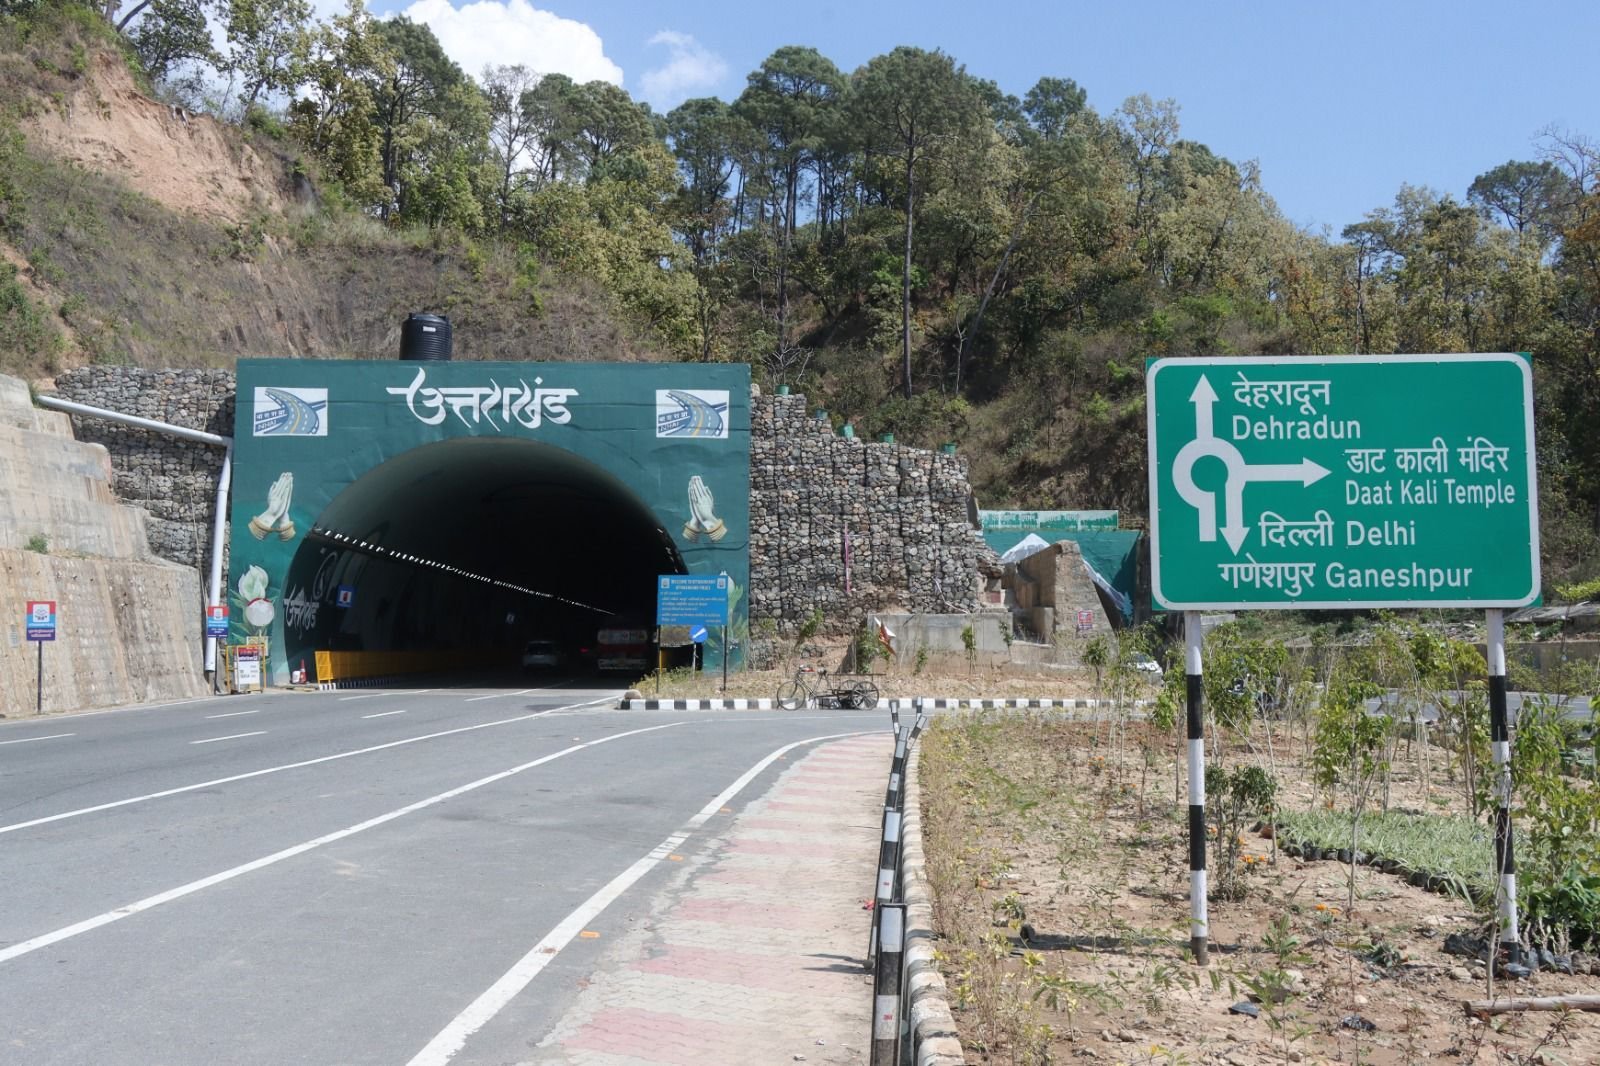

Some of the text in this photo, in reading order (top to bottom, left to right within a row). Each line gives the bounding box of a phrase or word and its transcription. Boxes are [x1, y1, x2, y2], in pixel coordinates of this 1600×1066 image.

[385, 367, 579, 432] उत्तराखंड
[1232, 371, 1331, 414] देहरादून
[1232, 414, 1361, 440] Dehradun
[1345, 437, 1510, 474] डाट काली मंदिर
[1345, 478, 1516, 509] Daat Kali Temple
[1258, 510, 1416, 547] दिल्ली Delhi
[1218, 552, 1473, 597] गणेशपुर Ganeshpur
